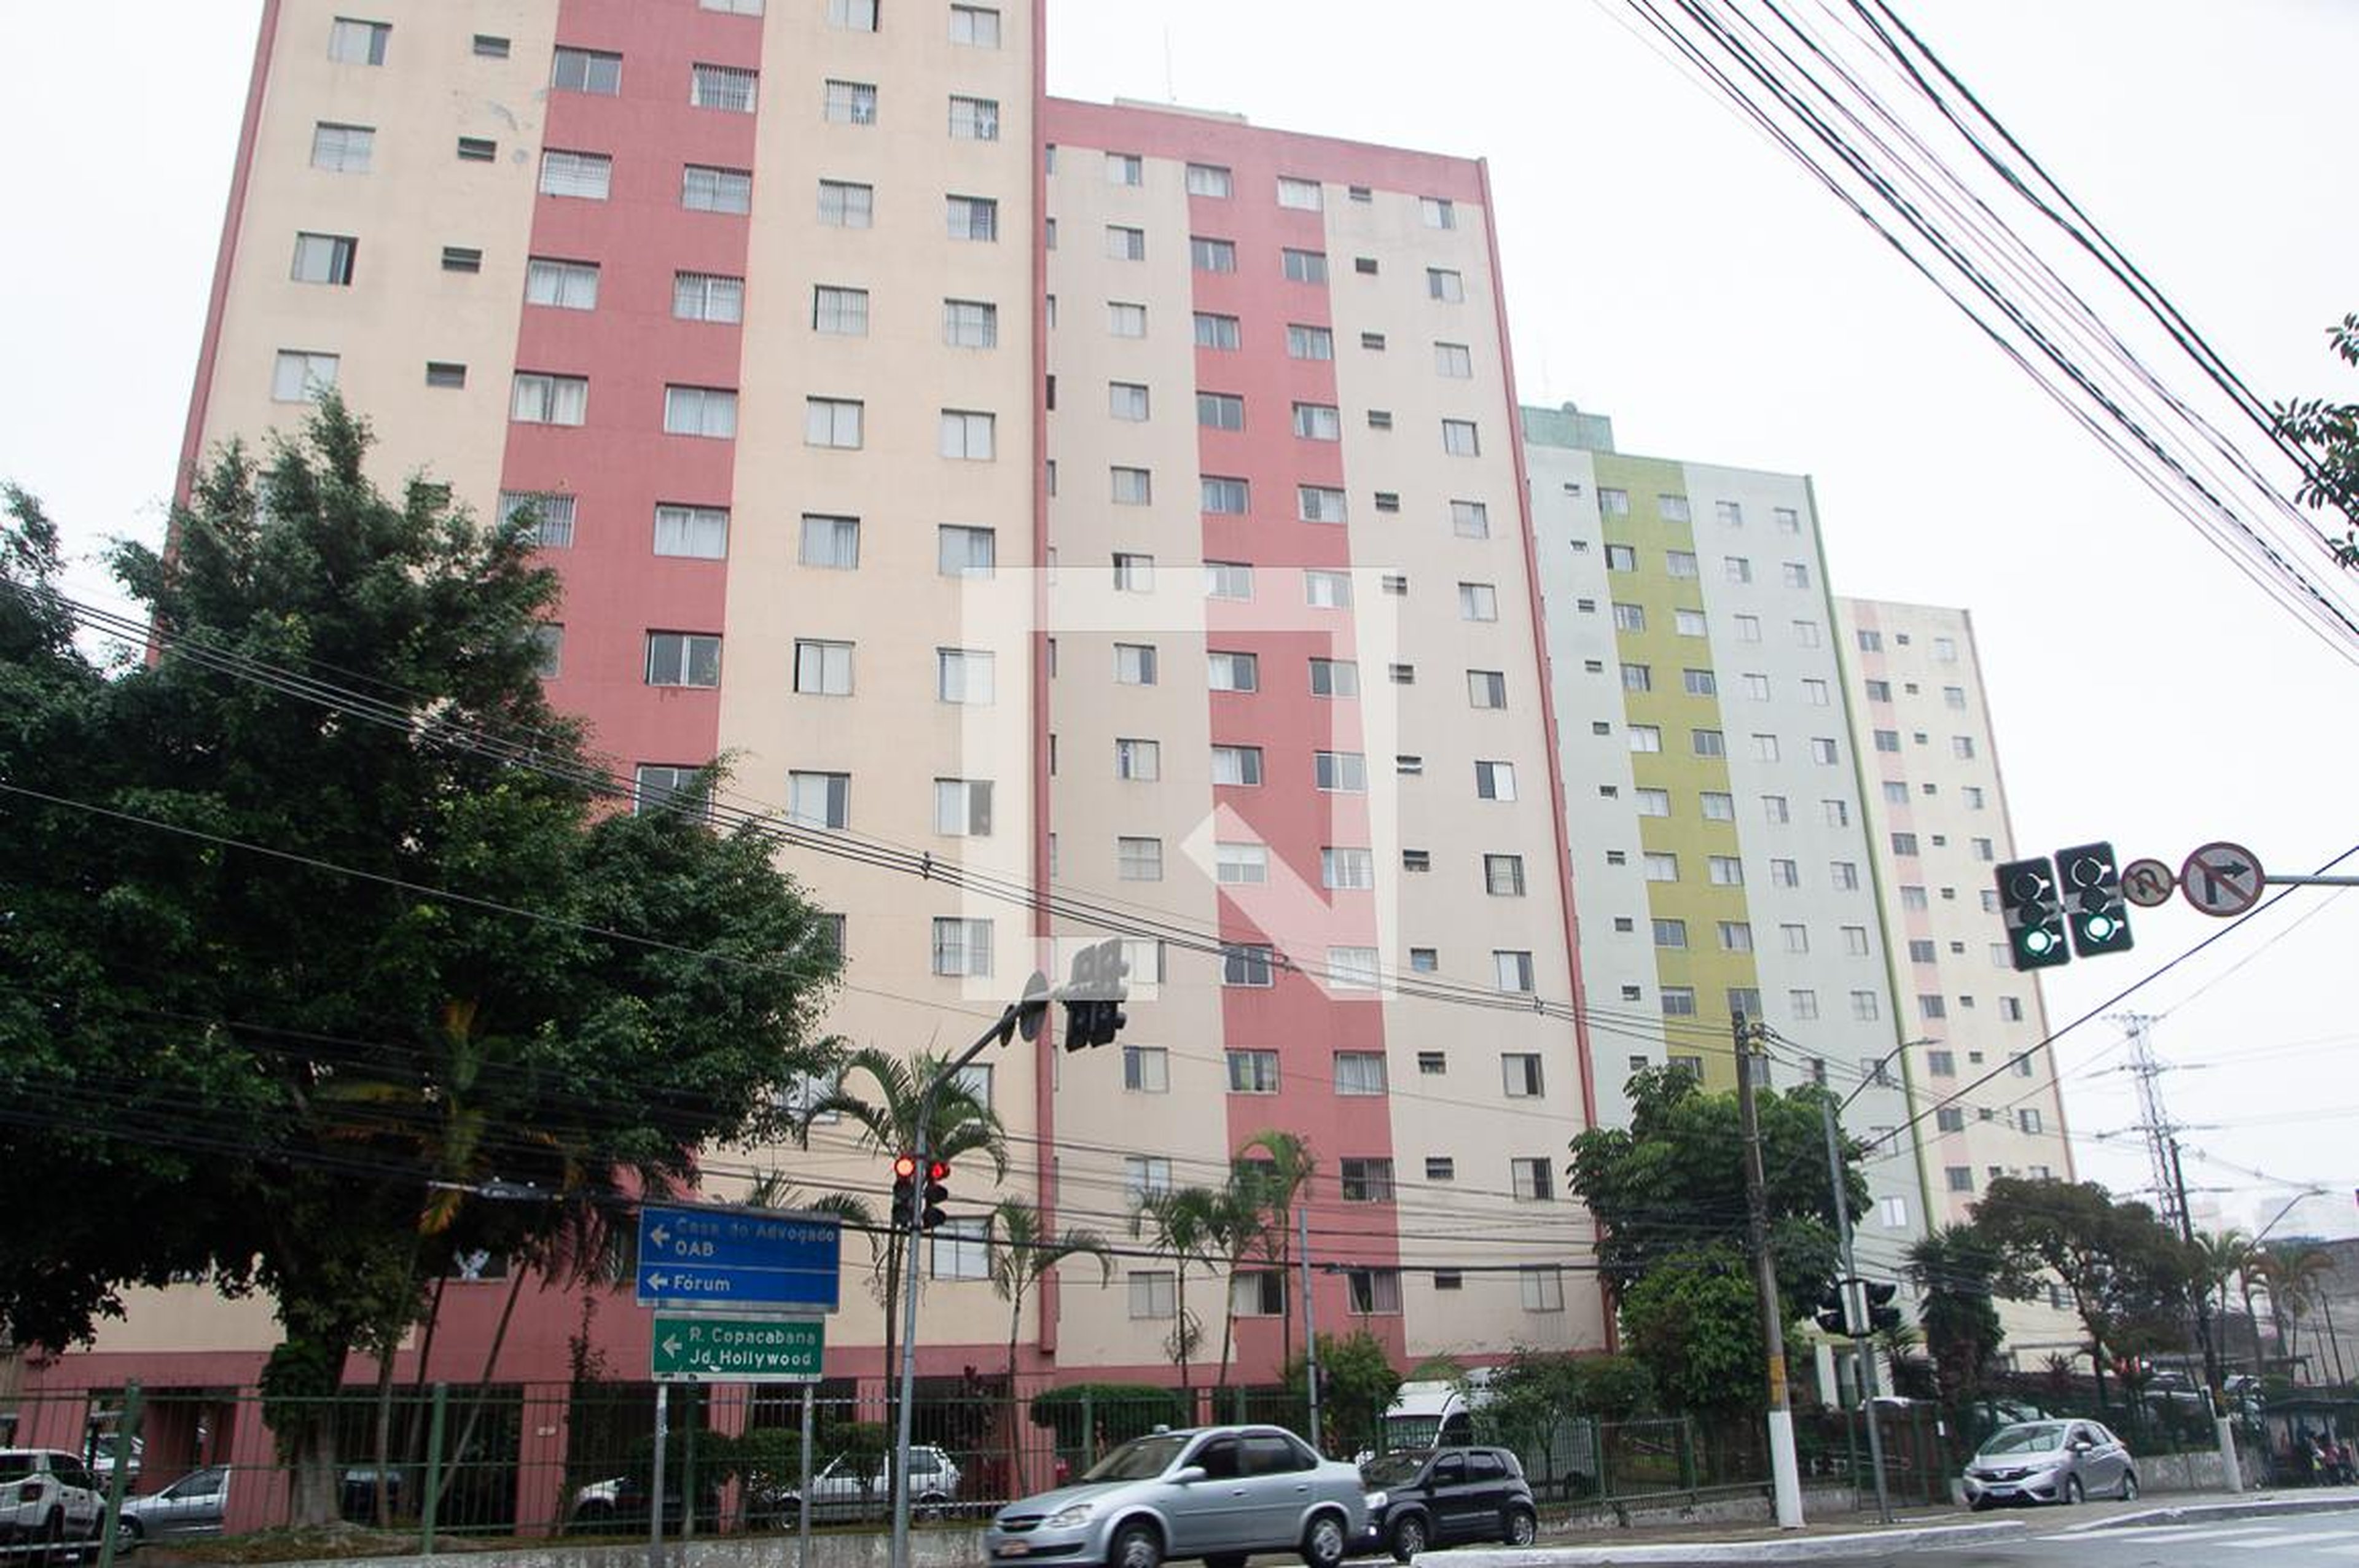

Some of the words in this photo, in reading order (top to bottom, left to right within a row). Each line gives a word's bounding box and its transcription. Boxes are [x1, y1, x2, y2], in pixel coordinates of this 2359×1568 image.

[675, 1240, 714, 1257] OAB
[674, 1274, 730, 1291] Fórum
[689, 1326, 705, 1343] R.
[712, 1327, 816, 1346] Copacabana
[689, 1349, 715, 1365] Jd.
[719, 1349, 812, 1369] Hollywood
